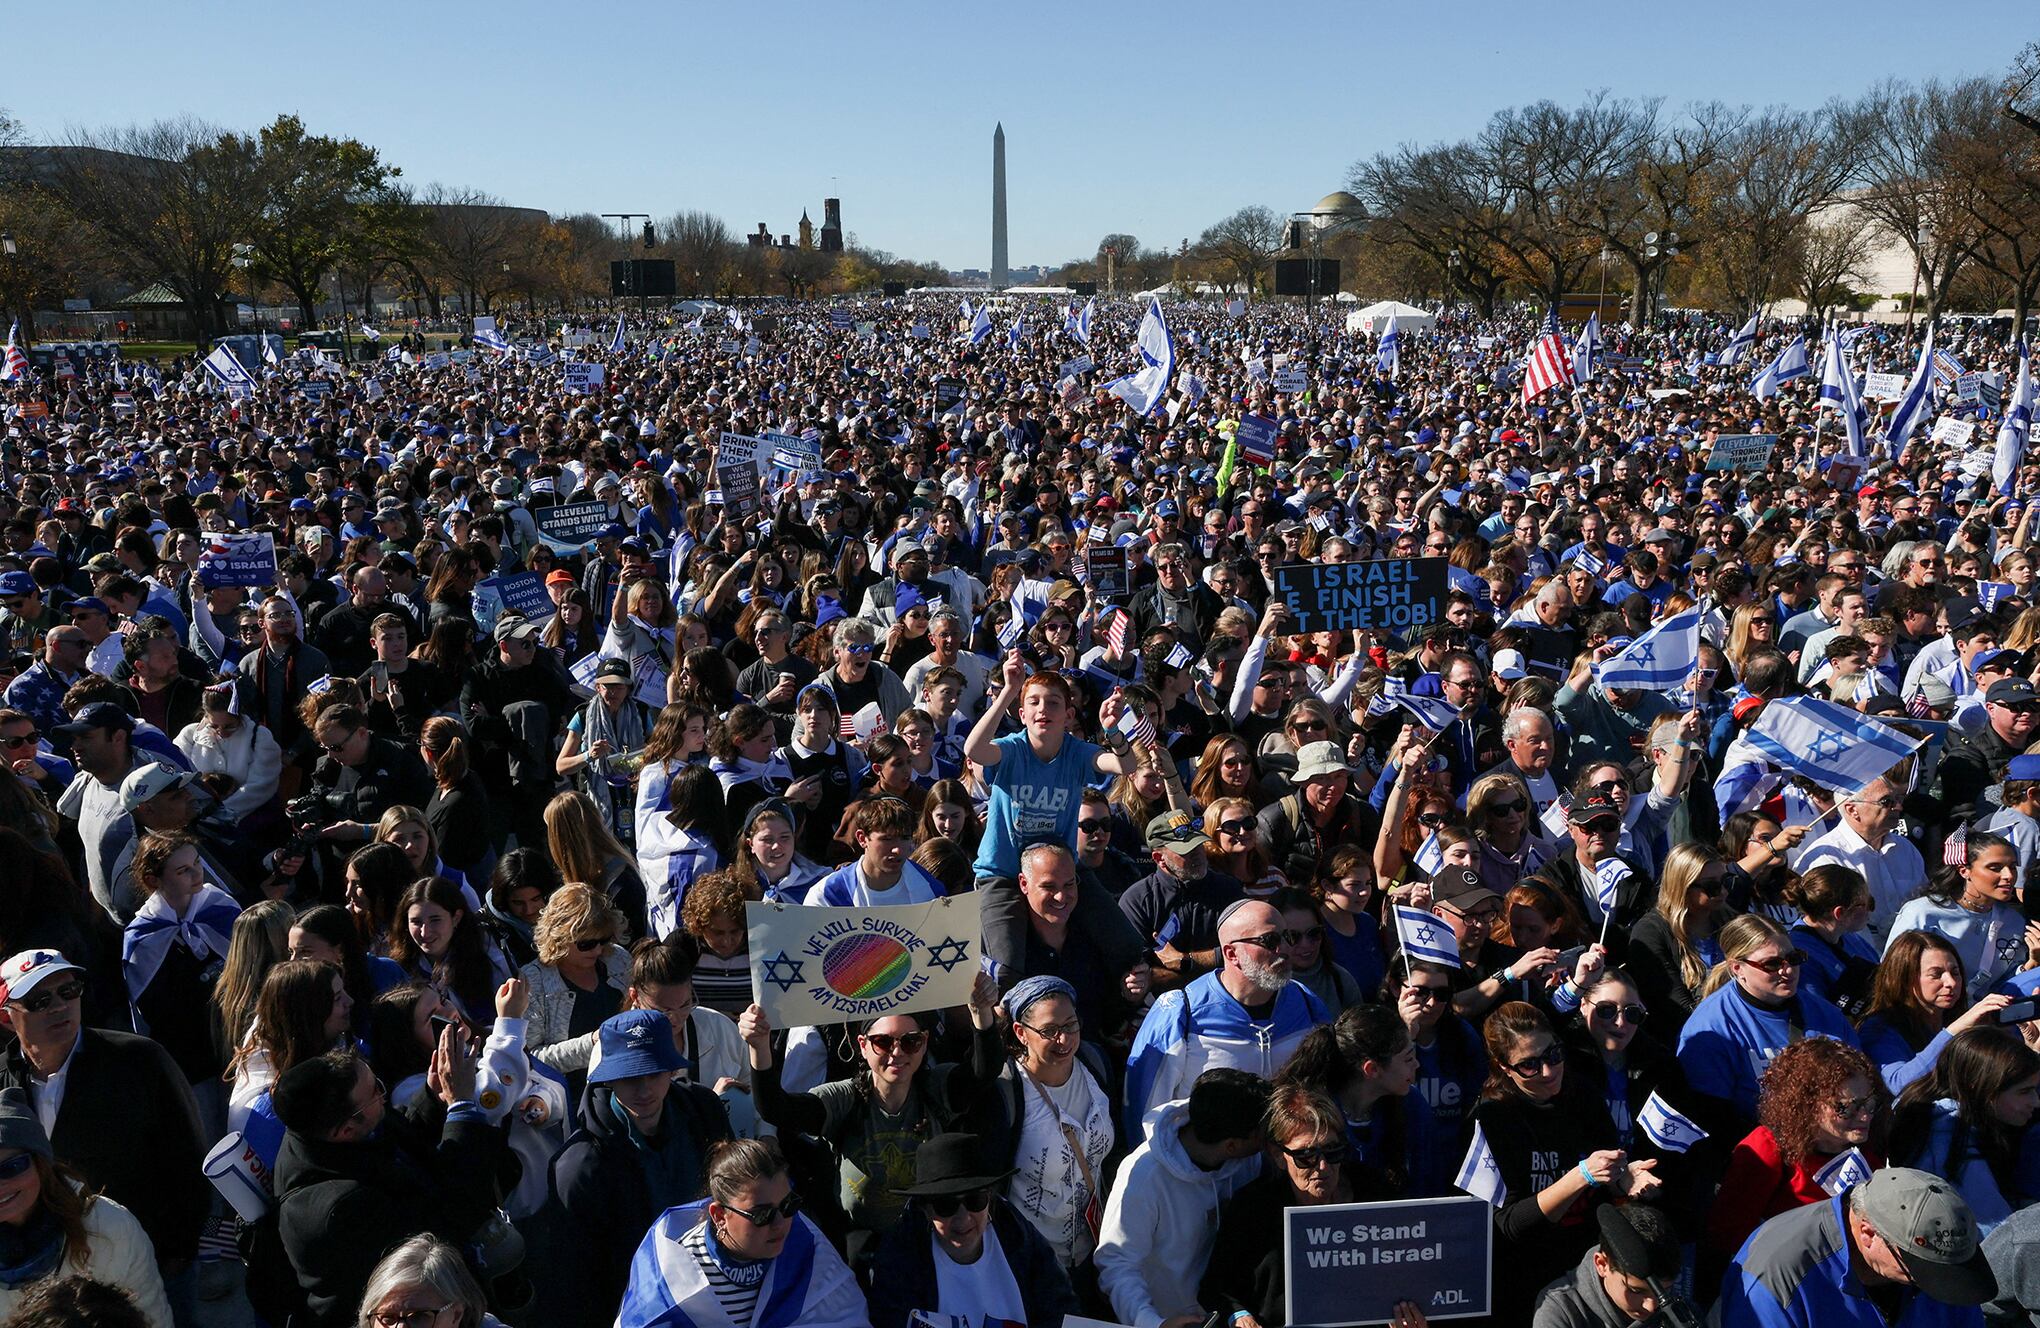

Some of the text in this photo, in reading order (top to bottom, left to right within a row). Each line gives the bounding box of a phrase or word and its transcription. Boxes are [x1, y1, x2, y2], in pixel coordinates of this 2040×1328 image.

[566, 365, 591, 374] BRING
[722, 434, 758, 450] BRING
[772, 435, 812, 452] CLEVELAND
[1720, 436, 1767, 450] CLEVELAND
[721, 444, 753, 459] THEM
[1731, 446, 1768, 458] STRONGER
[1729, 454, 1767, 465] THAN HATE
[727, 470, 752, 480] STAND
[731, 464, 745, 473] WE
[728, 483, 755, 494] ISRAEL
[730, 478, 751, 488] WITH
[553, 504, 606, 518] CLEVELAND
[542, 513, 606, 529] STANDS WITH
[575, 522, 601, 534] ISRA
[200, 560, 272, 570] DC ISRAEL
[1313, 561, 1419, 589] ISRAEL
[503, 577, 537, 592] BOSTON
[506, 586, 542, 602] STRONG.
[1318, 584, 1411, 611] FINISH
[1985, 586, 1998, 613] SRAEL
[1322, 596, 1437, 632] THE JOB!
[802, 917, 926, 957] WE WILL SURVIVE
[808, 987, 834, 1005] AM
[895, 972, 930, 1002] CHAI
[1306, 1221, 1426, 1245] We Stand
[1306, 1243, 1442, 1268] With Israel
[1431, 1290, 1469, 1305] ADL
